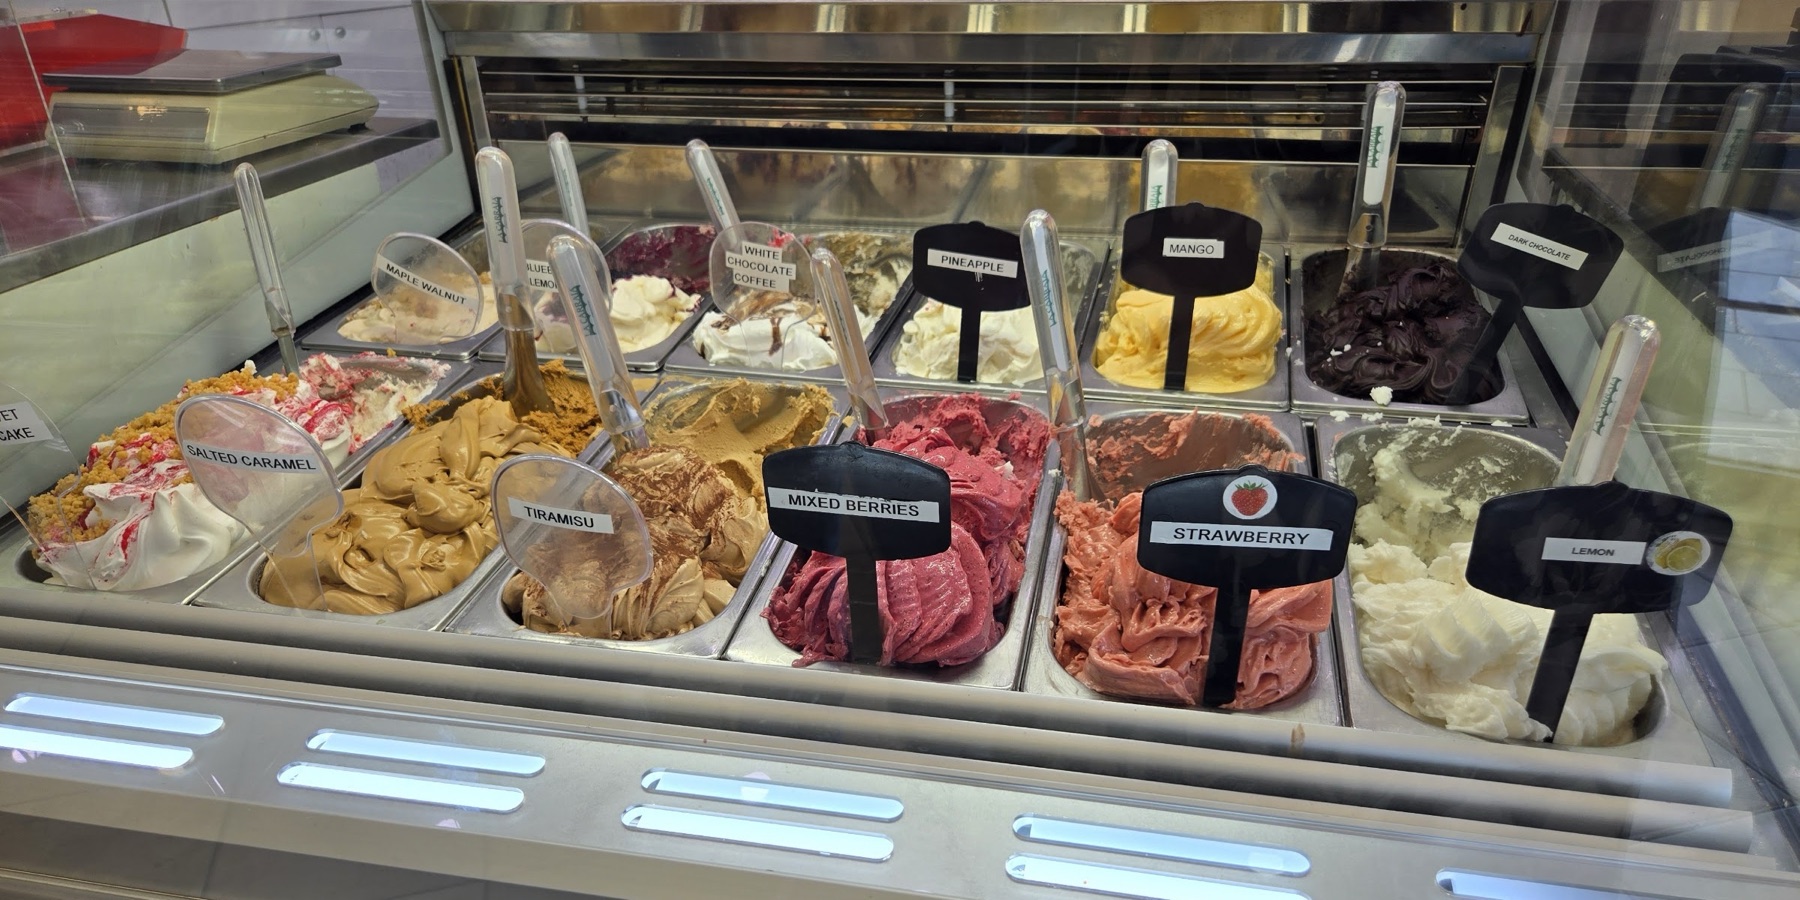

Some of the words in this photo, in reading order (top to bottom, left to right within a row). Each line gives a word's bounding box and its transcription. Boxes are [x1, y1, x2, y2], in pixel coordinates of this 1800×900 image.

[744, 245, 780, 261] WHITE
[1169, 244, 1215, 255] MANGO
[1508, 234, 1529, 246] DARK
[1528, 241, 1571, 261] CHOCOLATE
[727, 256, 793, 277] CHOCOLATE
[941, 255, 1004, 273] PINEAPPLE
[386, 263, 419, 287] MAPLE
[421, 281, 467, 304] WALNUT
[734, 272, 777, 288] COFFEE
[187, 444, 238, 465] SALTED
[241, 456, 316, 470] CARAMEL
[788, 494, 840, 510] MIXED
[846, 500, 919, 517] BERRIES
[523, 506, 595, 528] TIRAMISU
[1173, 527, 1311, 545] STRAWBERRY
[1571, 547, 1615, 557] LEMON
